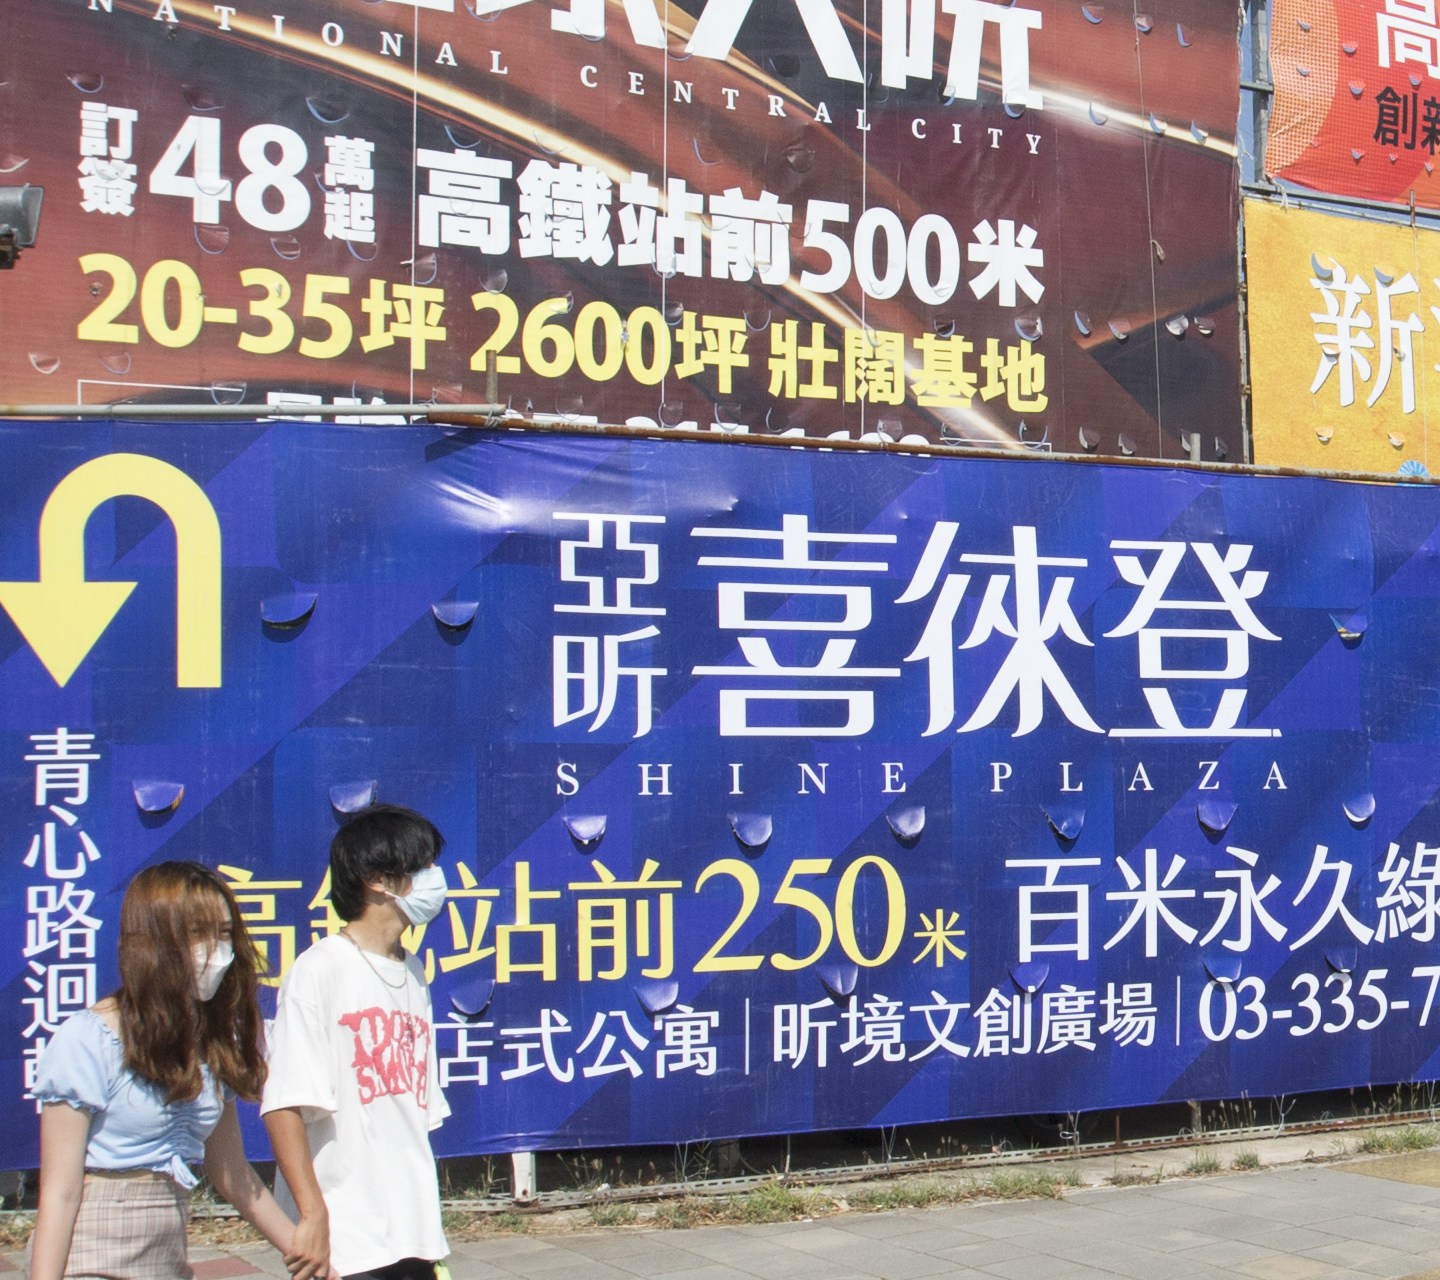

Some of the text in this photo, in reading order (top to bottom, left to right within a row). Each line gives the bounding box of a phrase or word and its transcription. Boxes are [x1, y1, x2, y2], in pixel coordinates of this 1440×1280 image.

[579, 63, 873, 133] CENTRAL
[909, 115, 1046, 157] CITY
[416, 145, 1045, 310] 高鐵站前500米
[76, 251, 1049, 415] 20-35坪 2600坪 壯闊基地
[551, 511, 668, 740] 亞昕
[690, 512, 1283, 739] 喜徠登
[556, 759, 1289, 798] SHINE PLAZA
[772, 980, 1158, 1070] 昕境文創廣場
